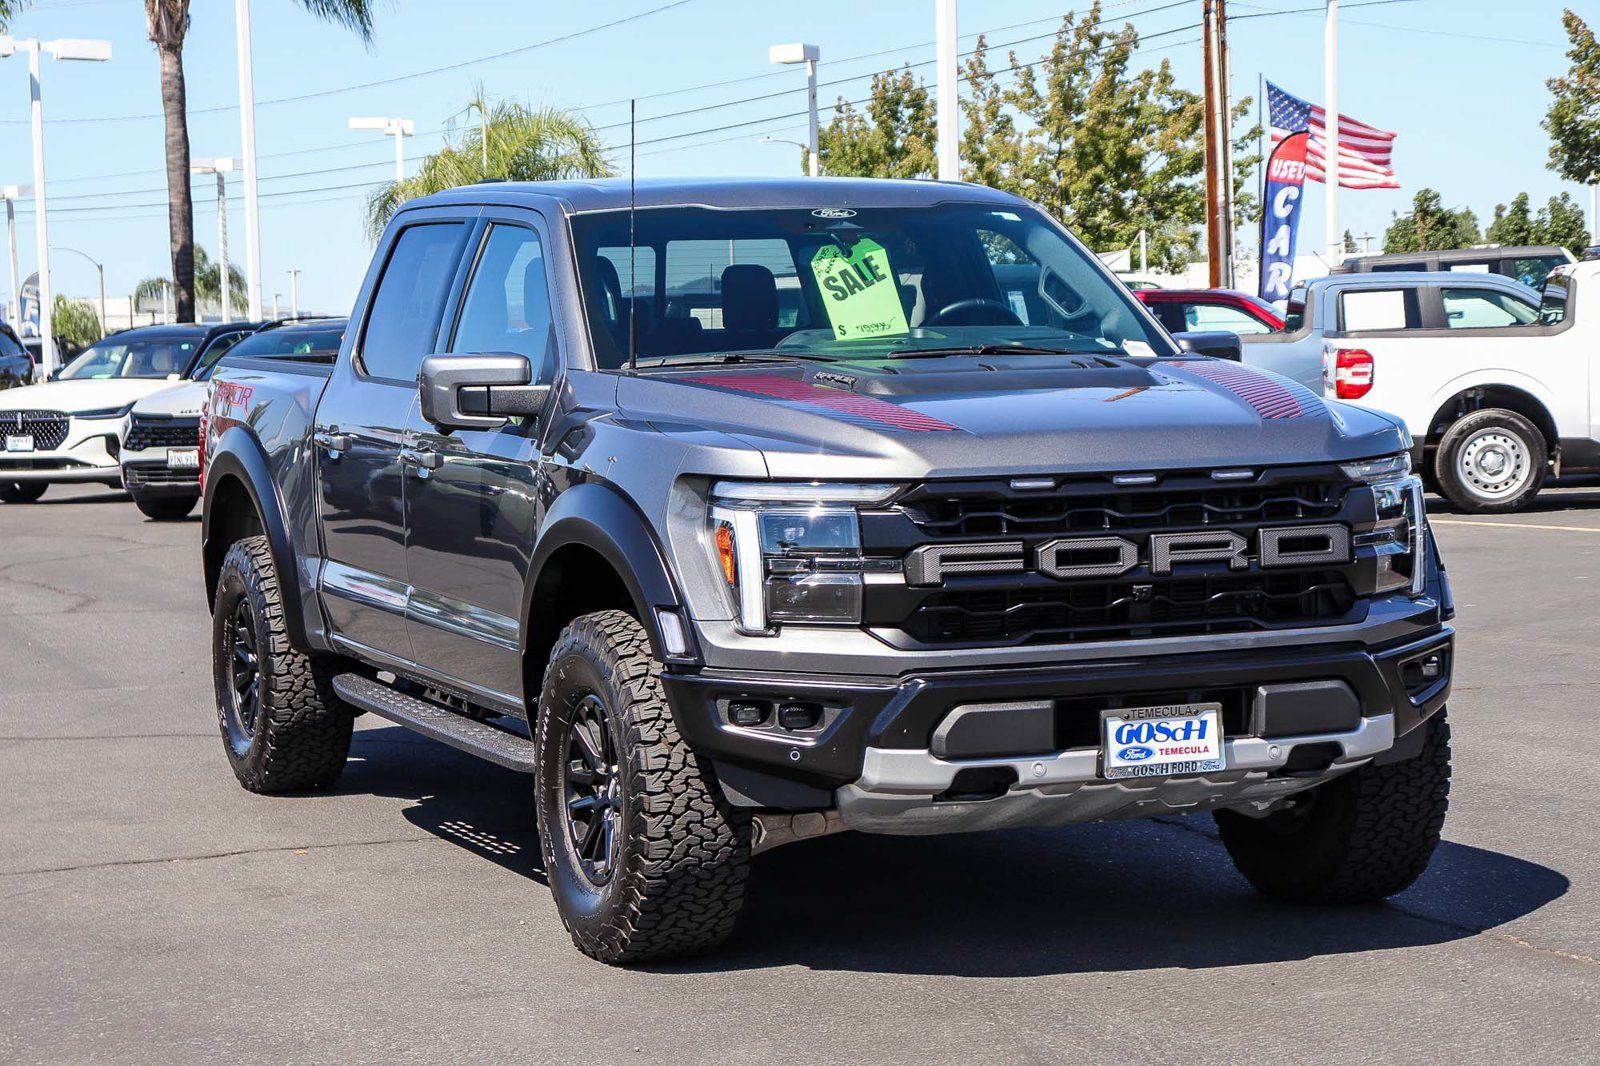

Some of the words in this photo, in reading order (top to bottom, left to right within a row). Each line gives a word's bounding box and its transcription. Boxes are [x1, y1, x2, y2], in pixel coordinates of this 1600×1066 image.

[1272, 158, 1305, 180] USED
[820, 208, 849, 218] Ford
[823, 255, 887, 301] SALE
[838, 324, 847, 336] $
[904, 523, 1351, 589] FORD
[1130, 706, 1194, 719] TEMECULA
[1124, 748, 1146, 760] Ford
[1159, 745, 1210, 756] TEMECULA
[1172, 761, 1198, 773] FORD
[1203, 761, 1221, 770] Ford
